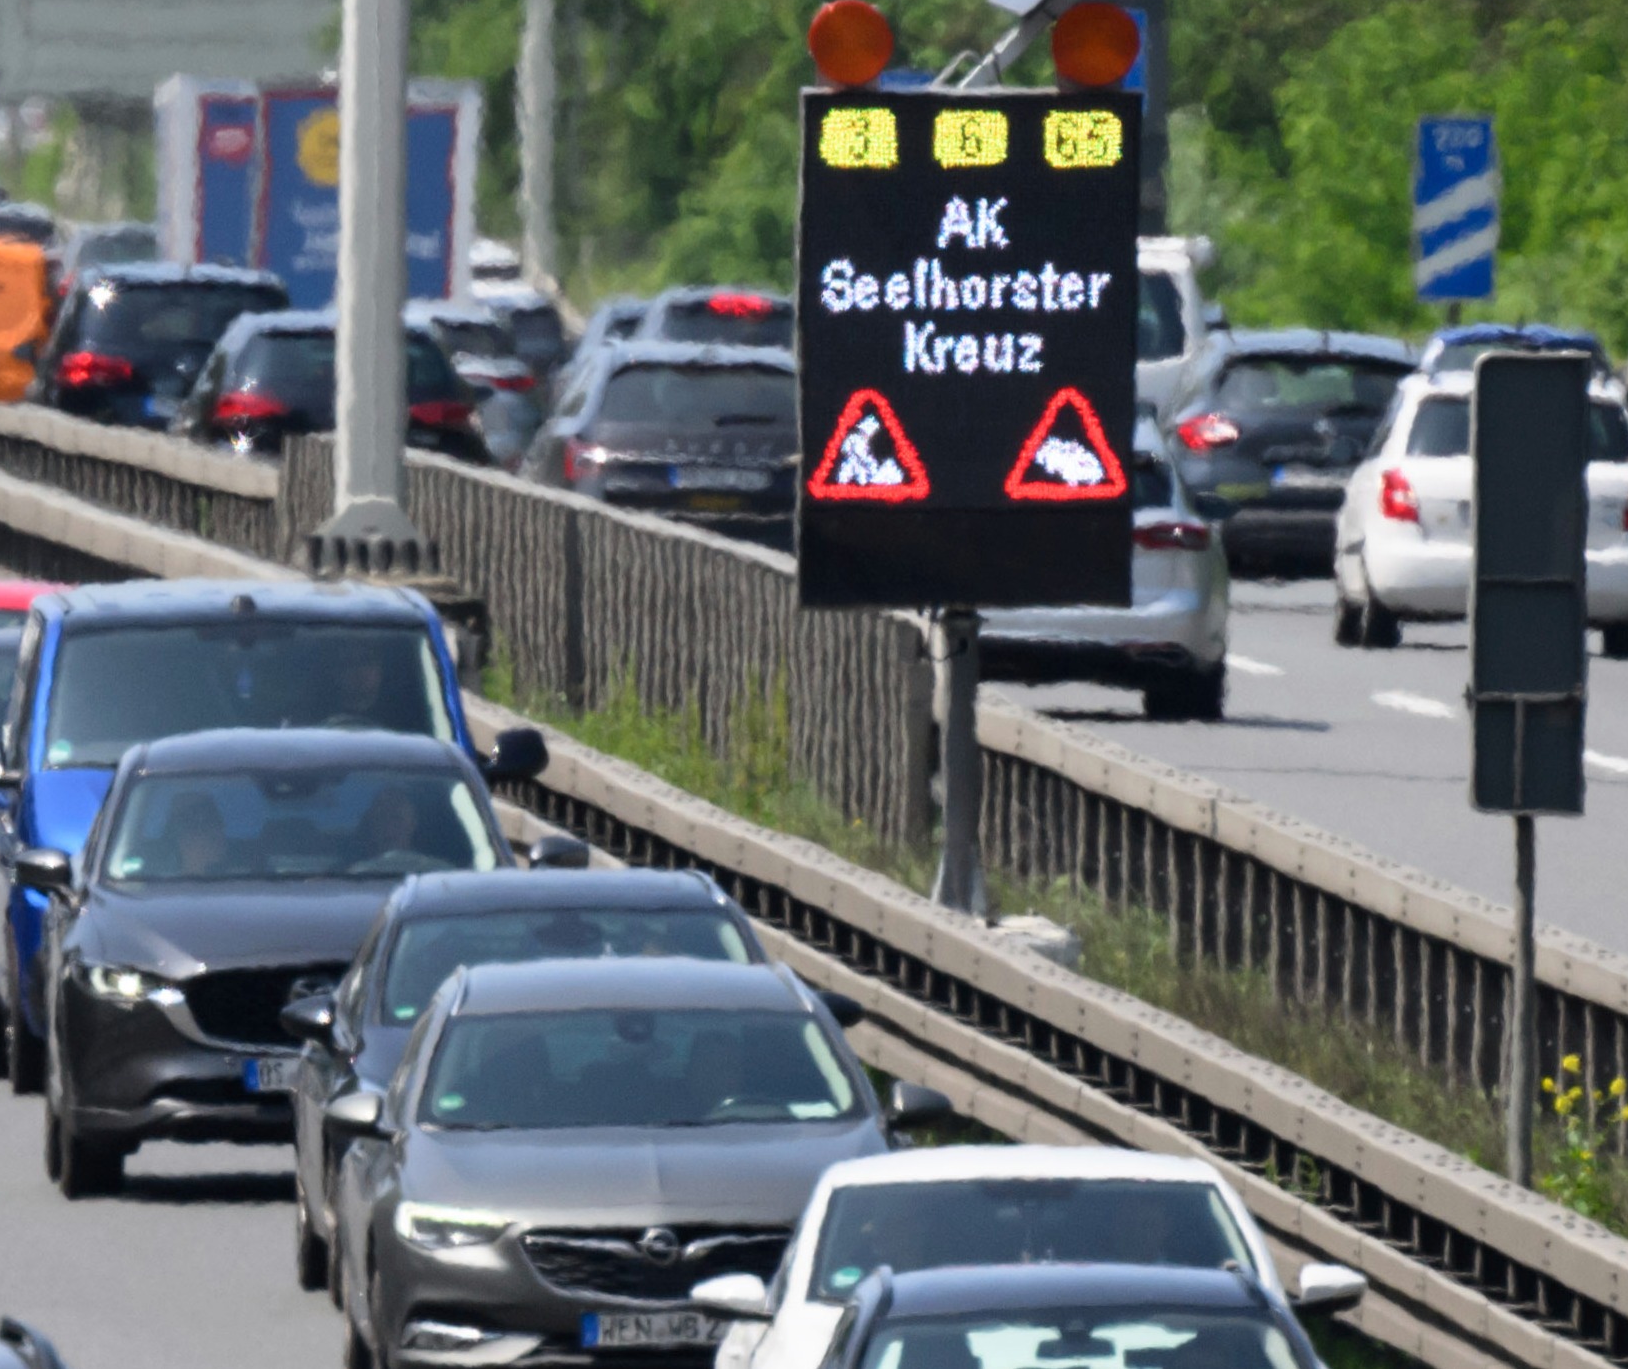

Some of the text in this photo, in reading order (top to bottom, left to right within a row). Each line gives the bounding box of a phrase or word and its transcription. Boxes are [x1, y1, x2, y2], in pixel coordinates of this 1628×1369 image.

[960, 116, 982, 159] 6
[1055, 116, 1109, 161] 65
[935, 192, 1011, 249] AK
[821, 256, 1113, 312] Seelhorster
[903, 319, 1045, 374] Kreuz
